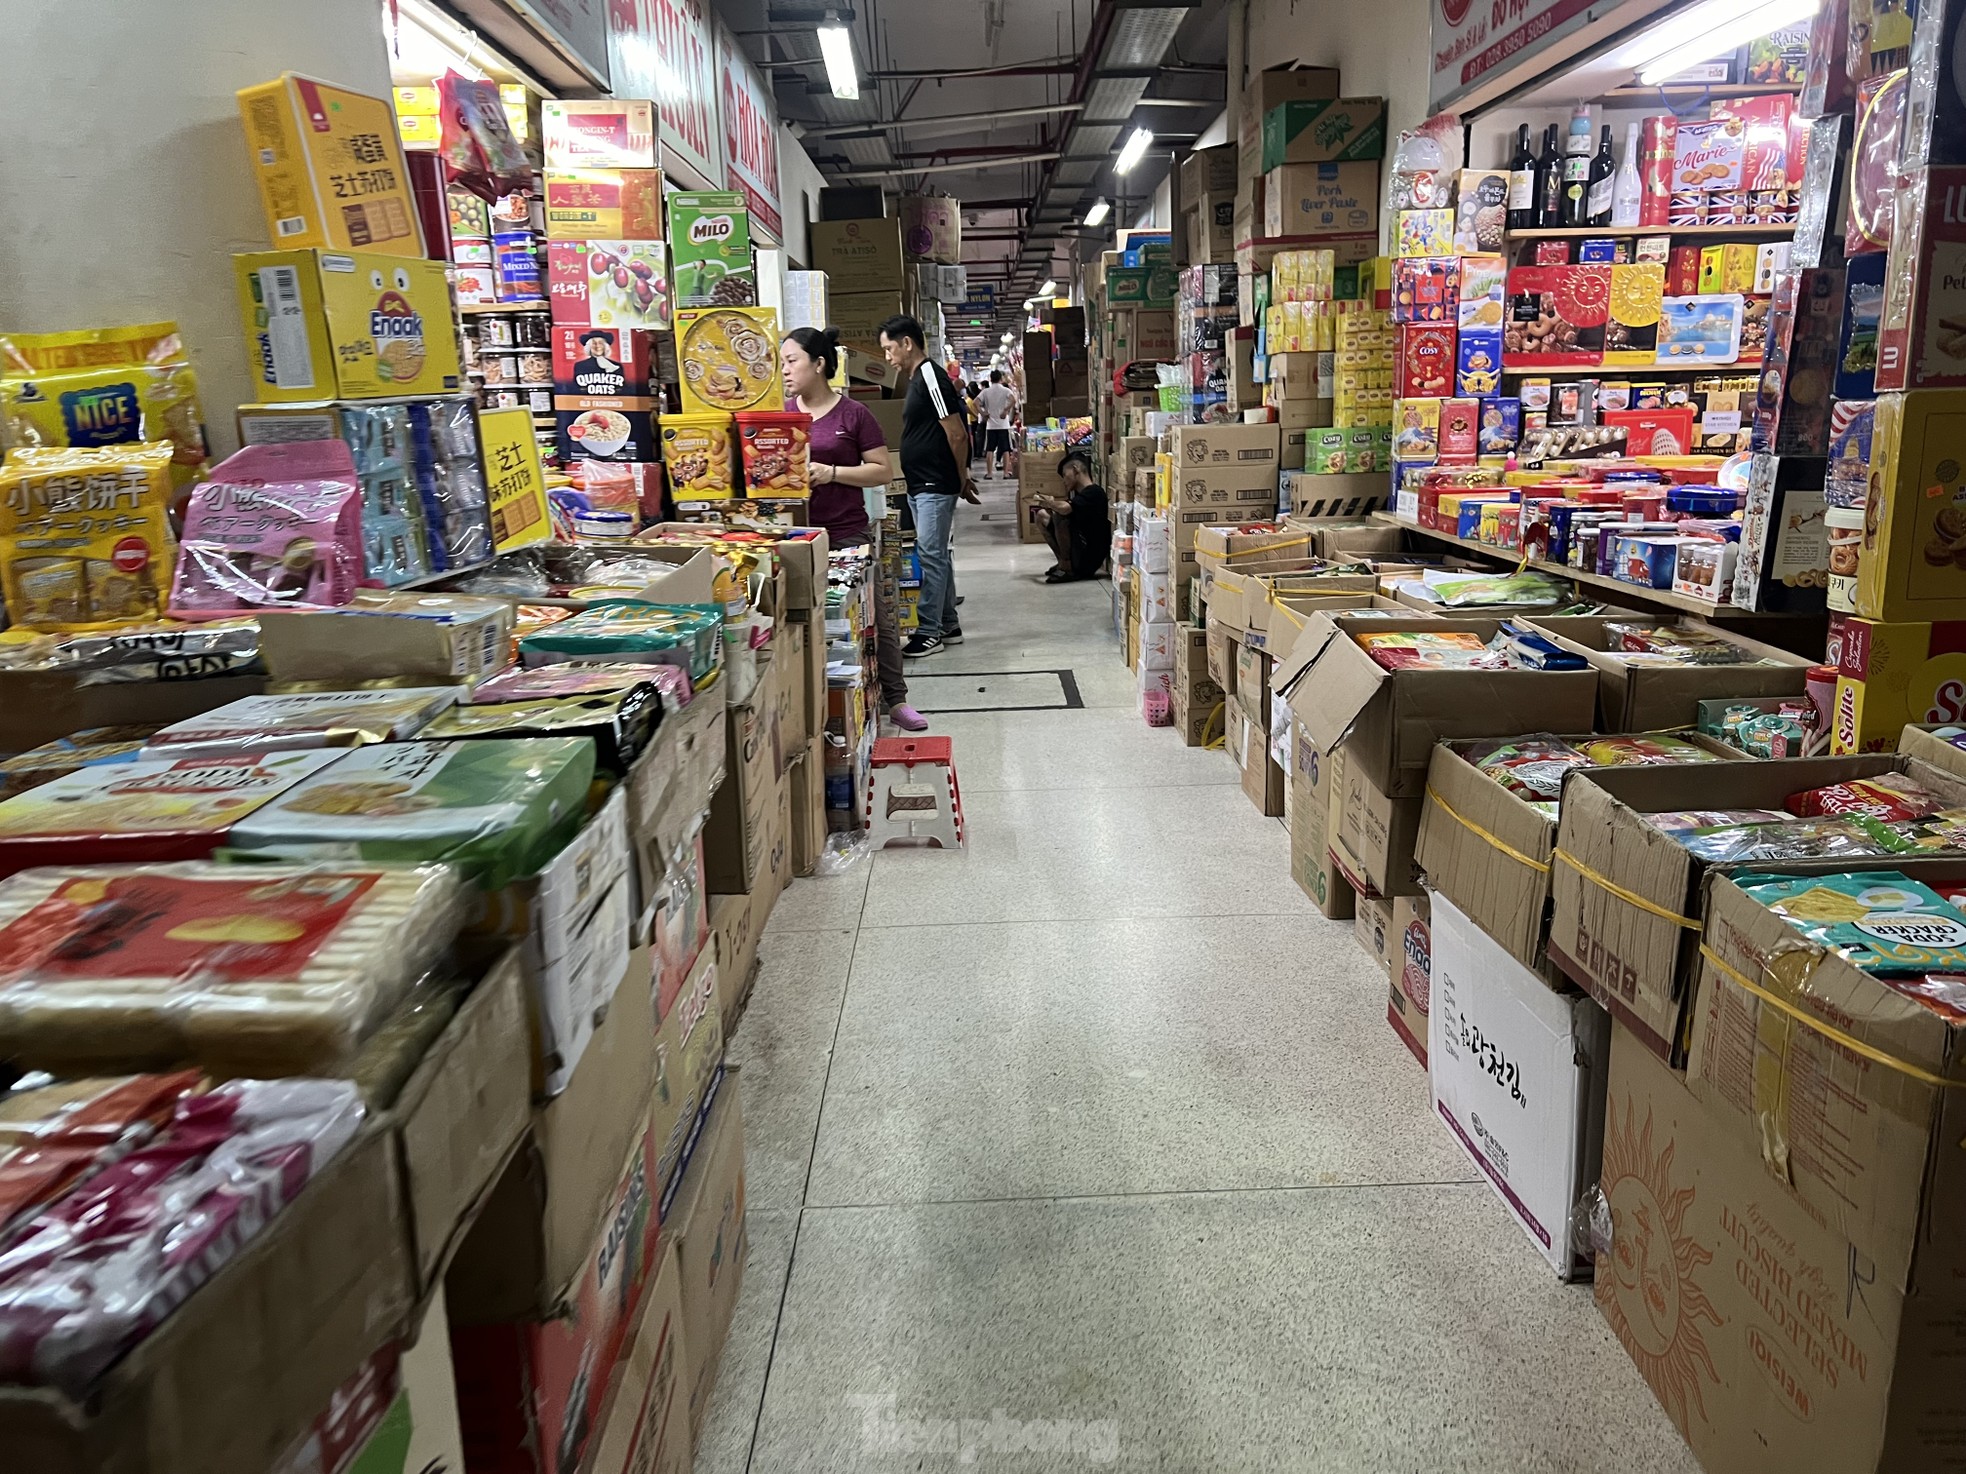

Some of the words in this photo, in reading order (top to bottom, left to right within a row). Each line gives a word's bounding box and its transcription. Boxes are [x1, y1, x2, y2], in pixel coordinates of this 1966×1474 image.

[1673, 144, 1731, 171] Marie
[693, 223, 730, 239] MILO
[369, 309, 424, 338] Enaak
[1881, 345, 1900, 370] LU
[575, 372, 625, 387] QUAKER
[587, 384, 616, 395] OATS
[73, 396, 133, 431] NICE
[1322, 434, 1343, 444] Cozy
[1838, 685, 1854, 749] Solite
[1871, 925, 1958, 935] CRACKER
[1898, 934, 1956, 943] SODA
[1402, 926, 1431, 976] Enaa
[1718, 1203, 1793, 1299] BISCUIT
[1735, 1258, 1839, 1390] SELECTED
[1796, 1288, 1868, 1383] MIXED
